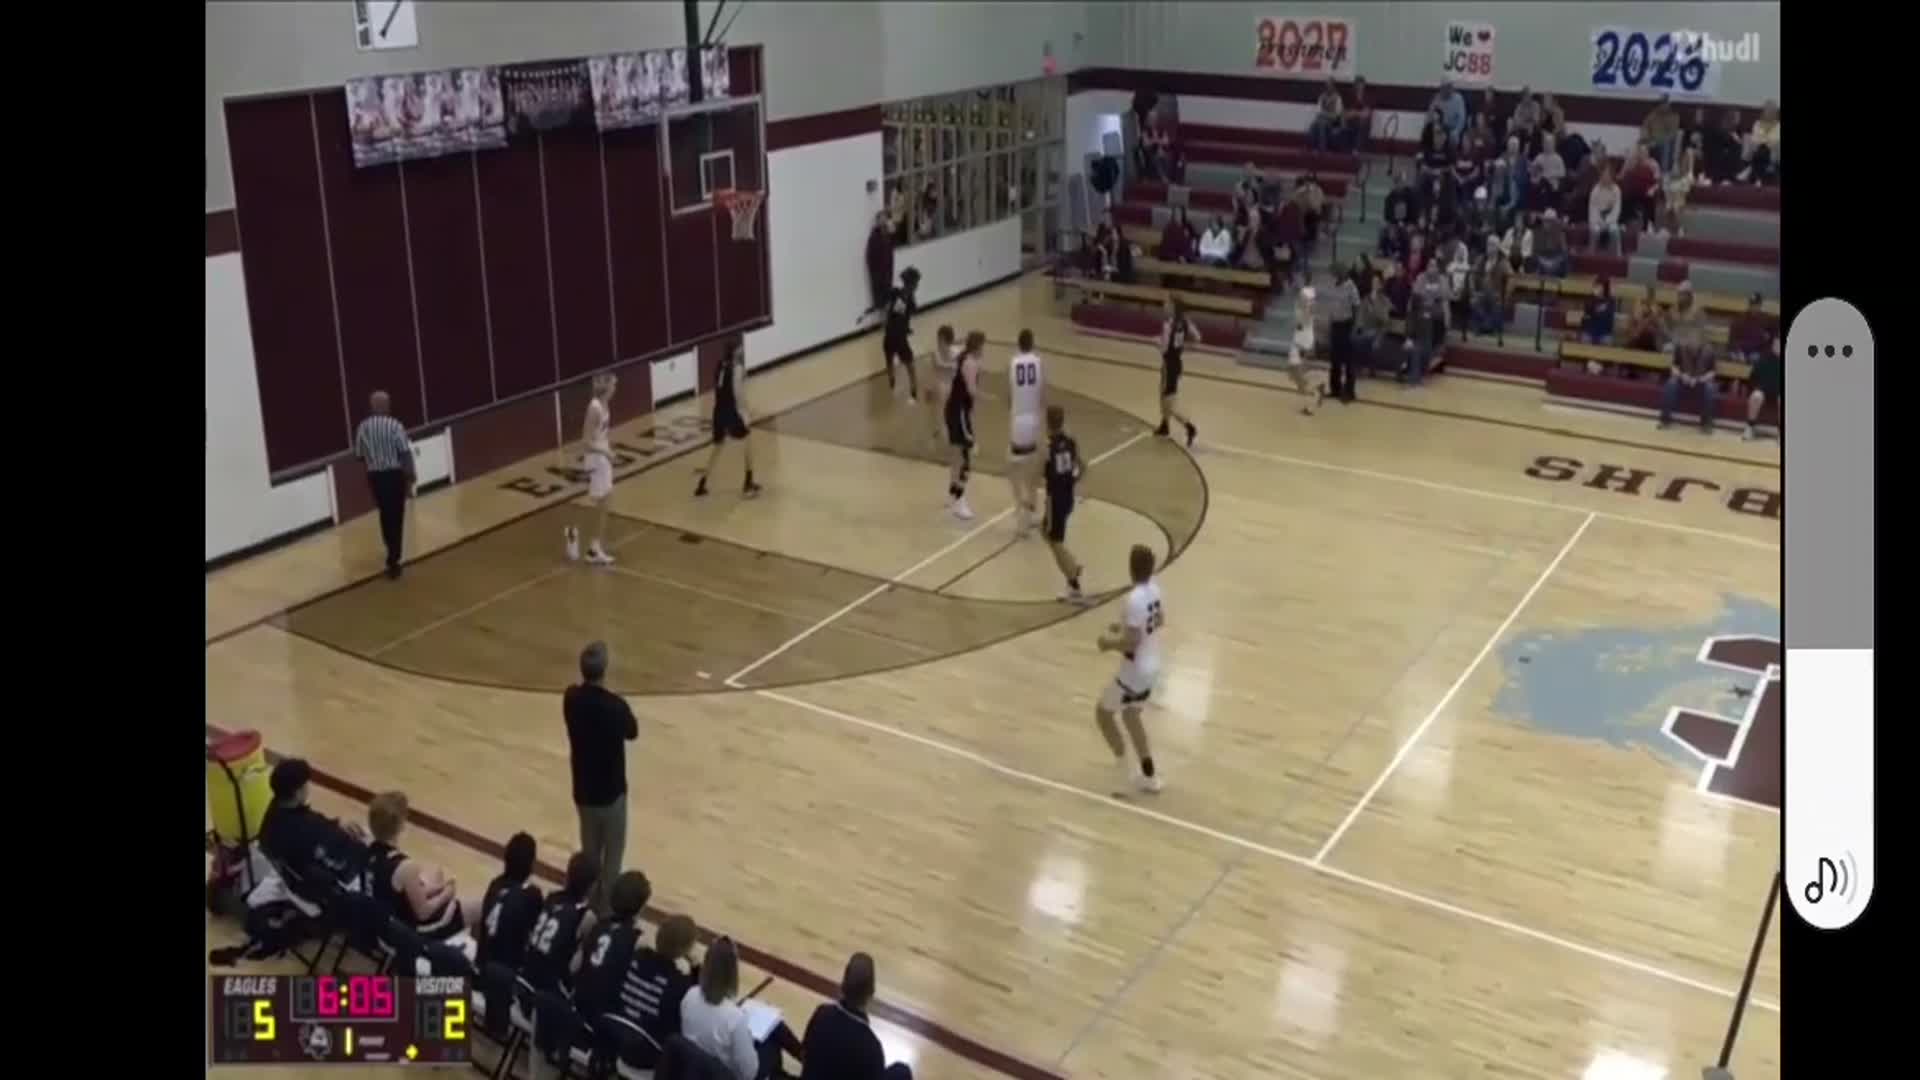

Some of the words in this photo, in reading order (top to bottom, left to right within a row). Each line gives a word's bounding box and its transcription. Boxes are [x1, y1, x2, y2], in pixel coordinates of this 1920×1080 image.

[1256, 19, 1347, 70] 2027
[1449, 25, 1472, 47] We
[1016, 362, 1037, 386] 00
